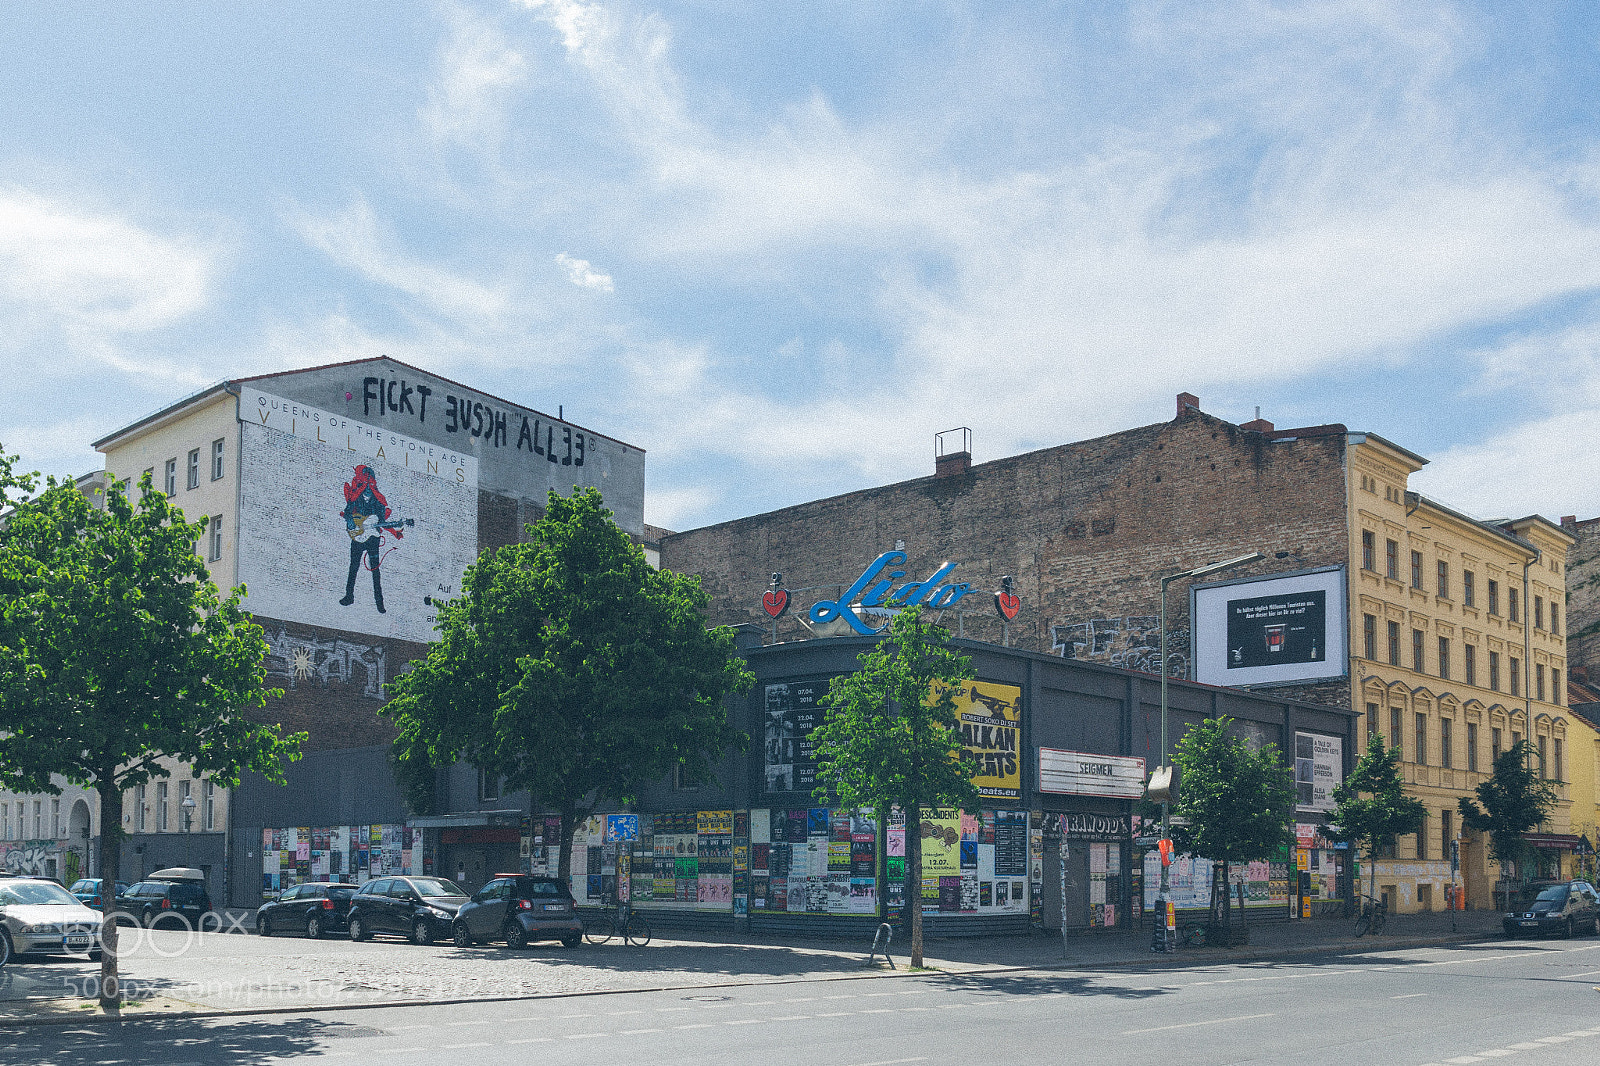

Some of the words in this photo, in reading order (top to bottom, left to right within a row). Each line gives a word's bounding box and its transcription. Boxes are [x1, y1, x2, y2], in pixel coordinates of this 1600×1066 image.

[363, 376, 432, 422] FICKT
[258, 396, 320, 422] QUEENS
[330, 418, 346, 429] OF
[356, 425, 382, 441] THE
[390, 436, 434, 456] STONE
[442, 453, 465, 466] AGE
[258, 408, 465, 482] VILLAINS
[438, 583, 452, 593] Auf
[809, 550, 978, 635] Lido
[961, 713, 984, 723] ROBERT
[985, 716, 1000, 725] SOKO
[953, 720, 1016, 752] ALKAN
[959, 750, 1017, 778] BEATS
[1080, 762, 1113, 776] SEIGMEN
[1052, 814, 1119, 834] PRANOID
[940, 878, 960, 887] BASH
